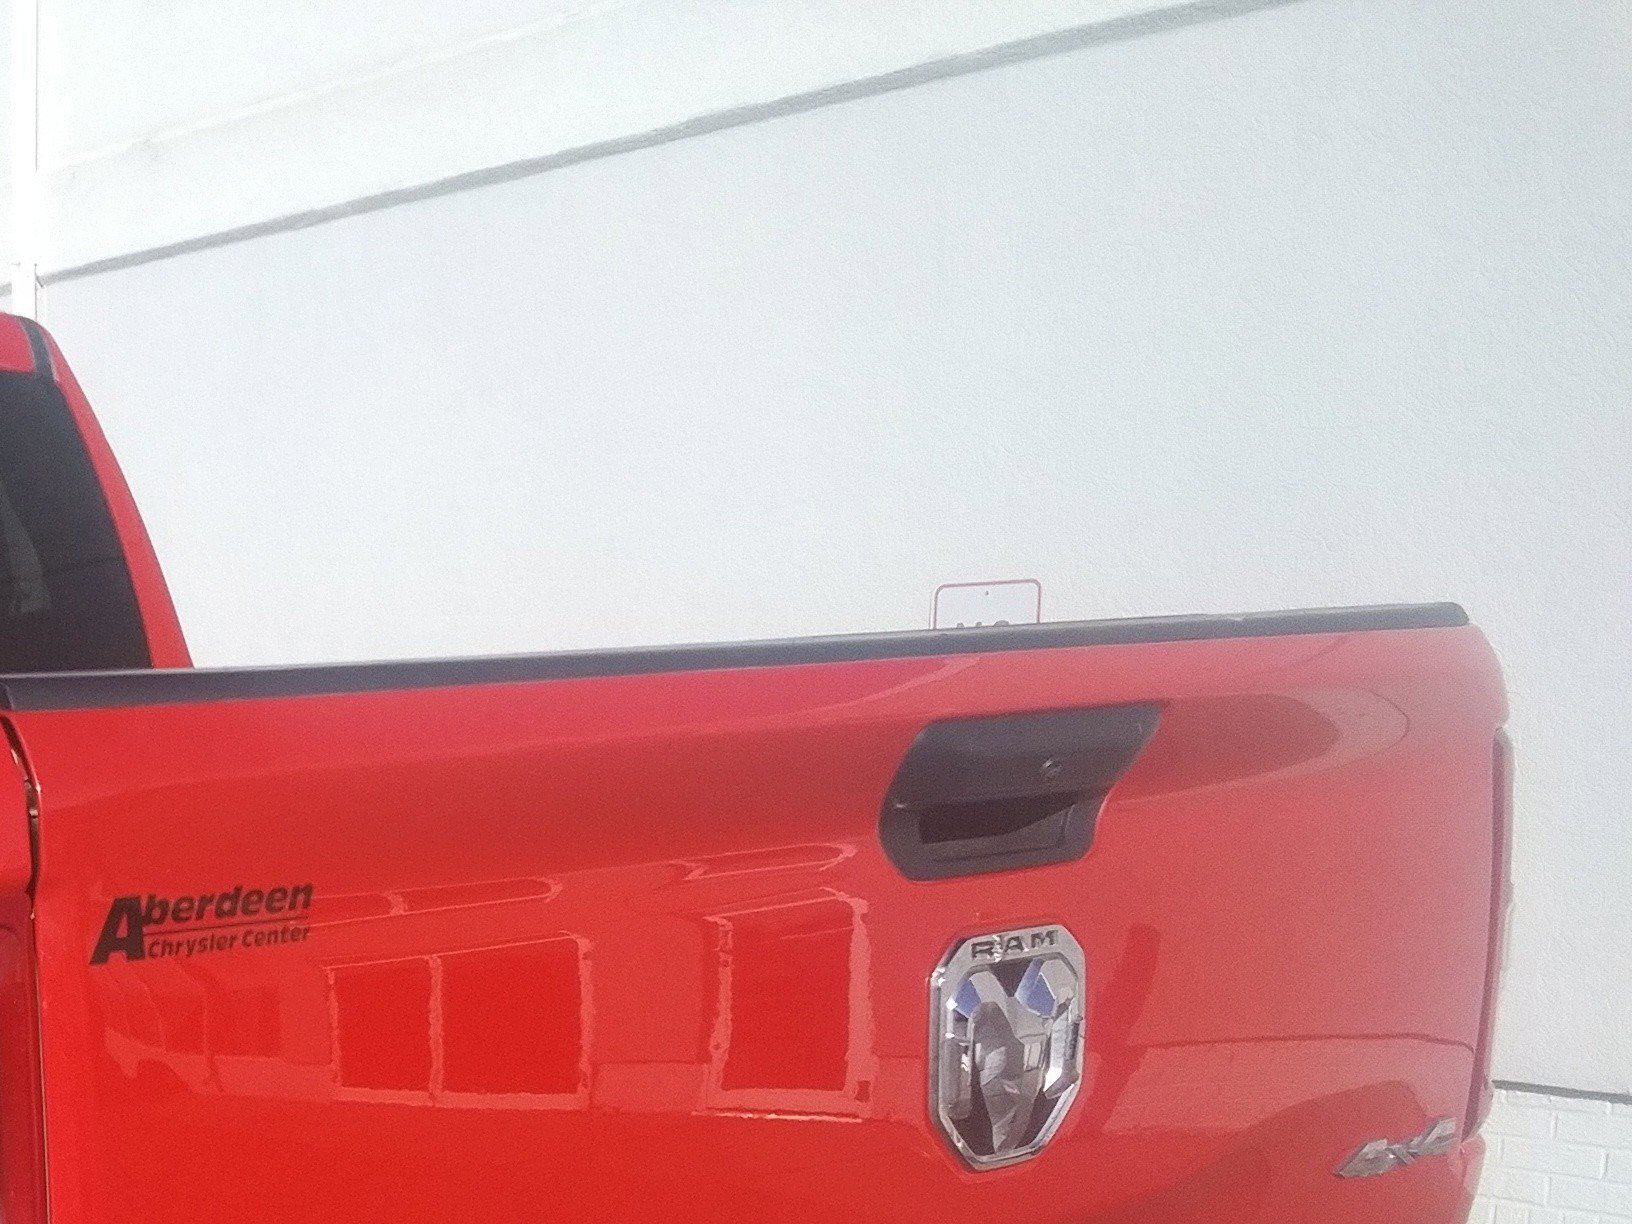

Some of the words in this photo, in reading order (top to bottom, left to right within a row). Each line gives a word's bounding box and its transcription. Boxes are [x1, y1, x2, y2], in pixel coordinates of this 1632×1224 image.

[89, 883, 314, 966] Aberdeen
[147, 931, 237, 960] Chrysler
[241, 924, 310, 947] Center
[971, 929, 1058, 958] RAM
